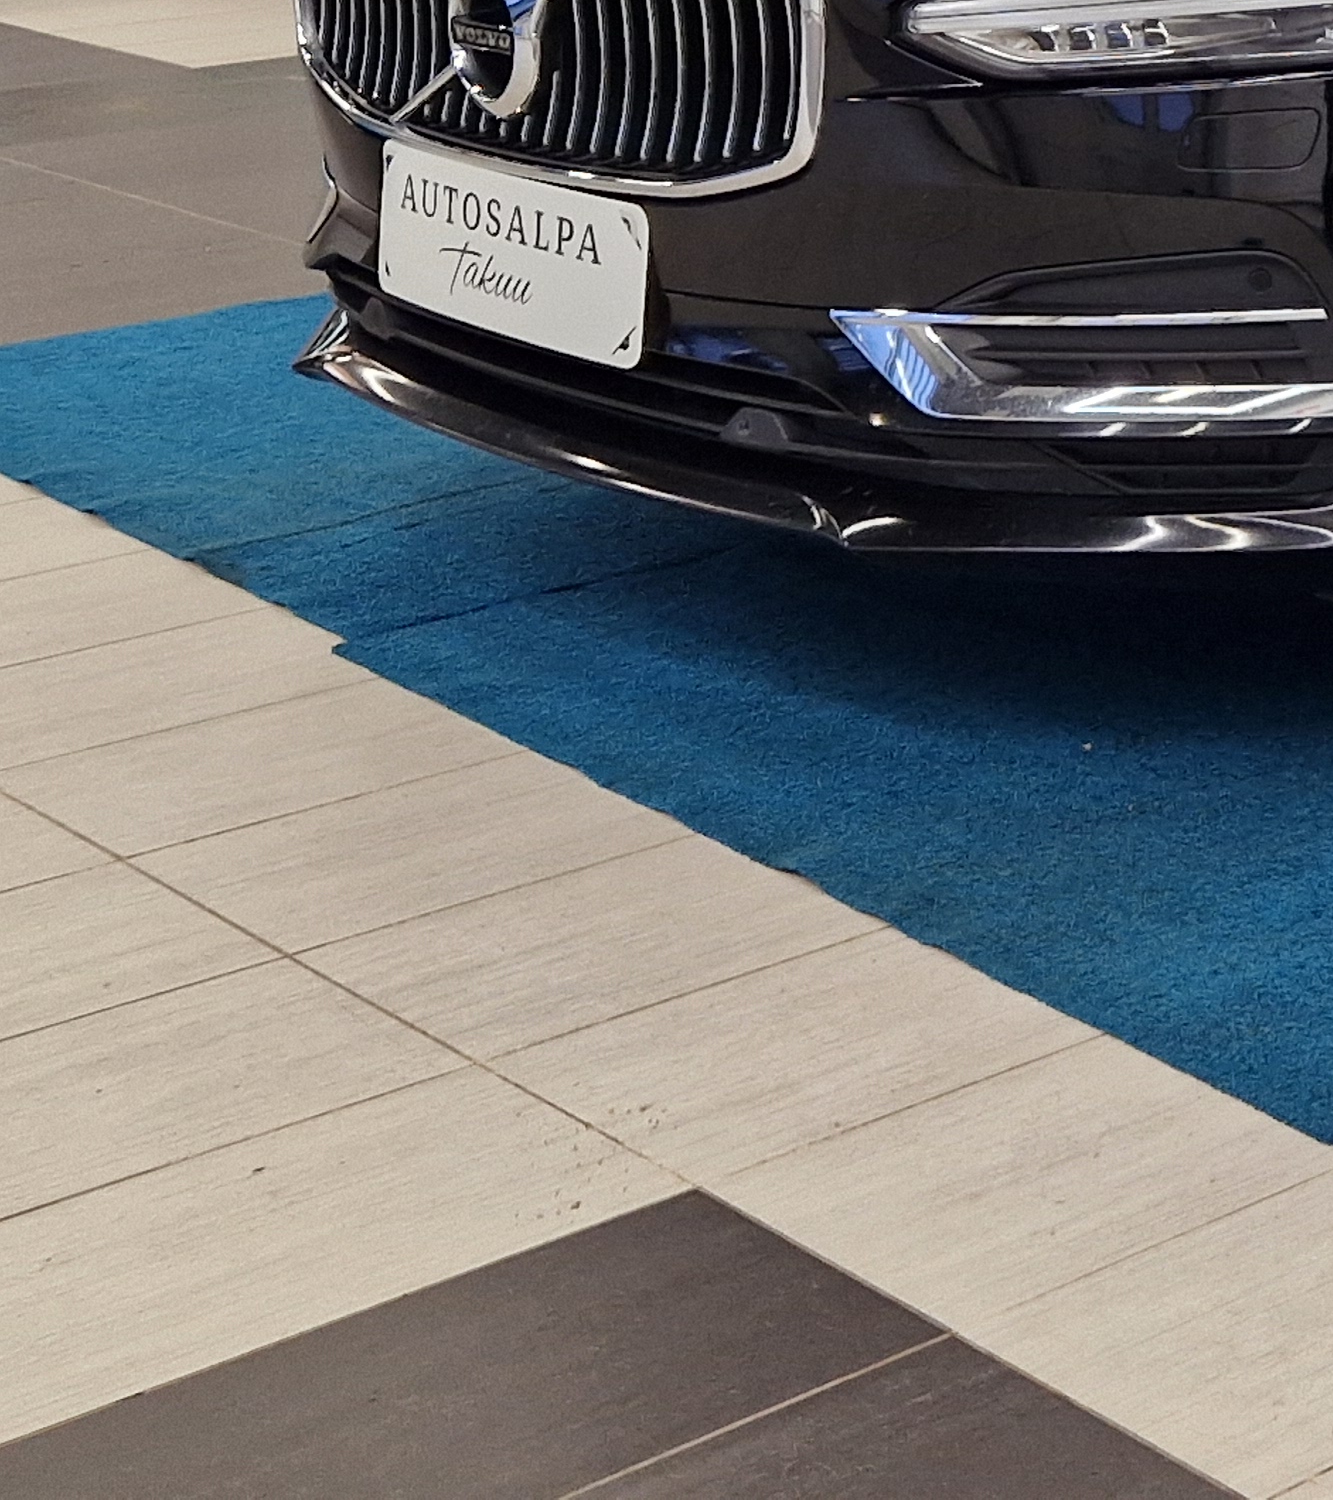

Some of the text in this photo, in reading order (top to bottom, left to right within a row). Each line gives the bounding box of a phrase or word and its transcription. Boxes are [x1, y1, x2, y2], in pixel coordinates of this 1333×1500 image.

[454, 23, 511, 49] VOLVO
[400, 173, 601, 266] AUTOSALPA
[439, 241, 533, 304] Takuu
